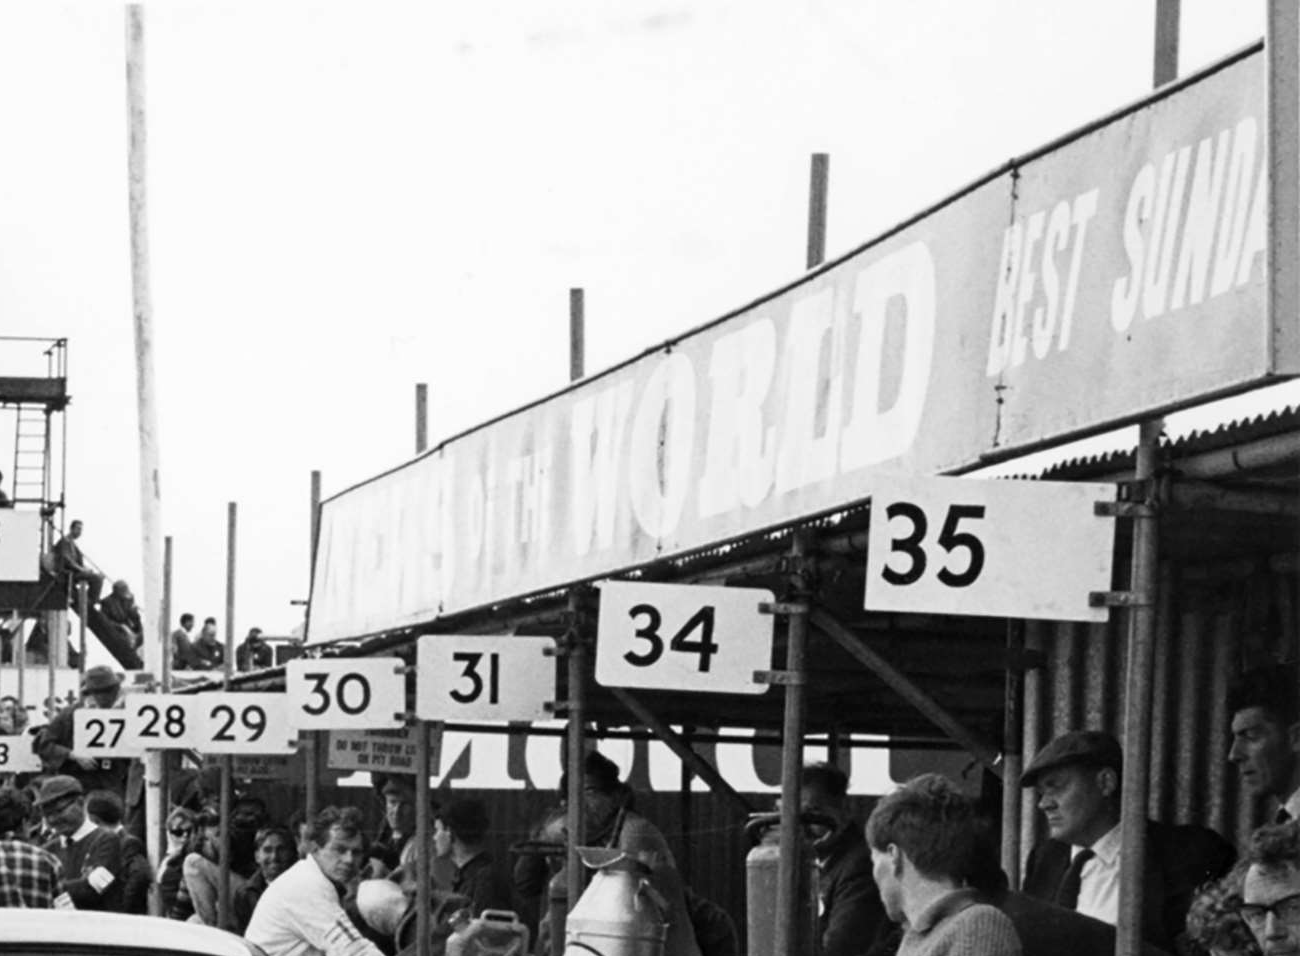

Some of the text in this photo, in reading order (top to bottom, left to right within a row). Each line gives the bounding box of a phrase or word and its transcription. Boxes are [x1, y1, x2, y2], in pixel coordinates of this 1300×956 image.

[570, 241, 936, 557] WORLD
[987, 187, 1100, 377] BEST
[881, 501, 986, 588] 35
[623, 603, 719, 673] 34
[302, 672, 371, 715] 30
[449, 652, 500, 705] 31
[85, 718, 126, 748] 27
[137, 704, 186, 738] 28
[210, 704, 267, 742] 29
